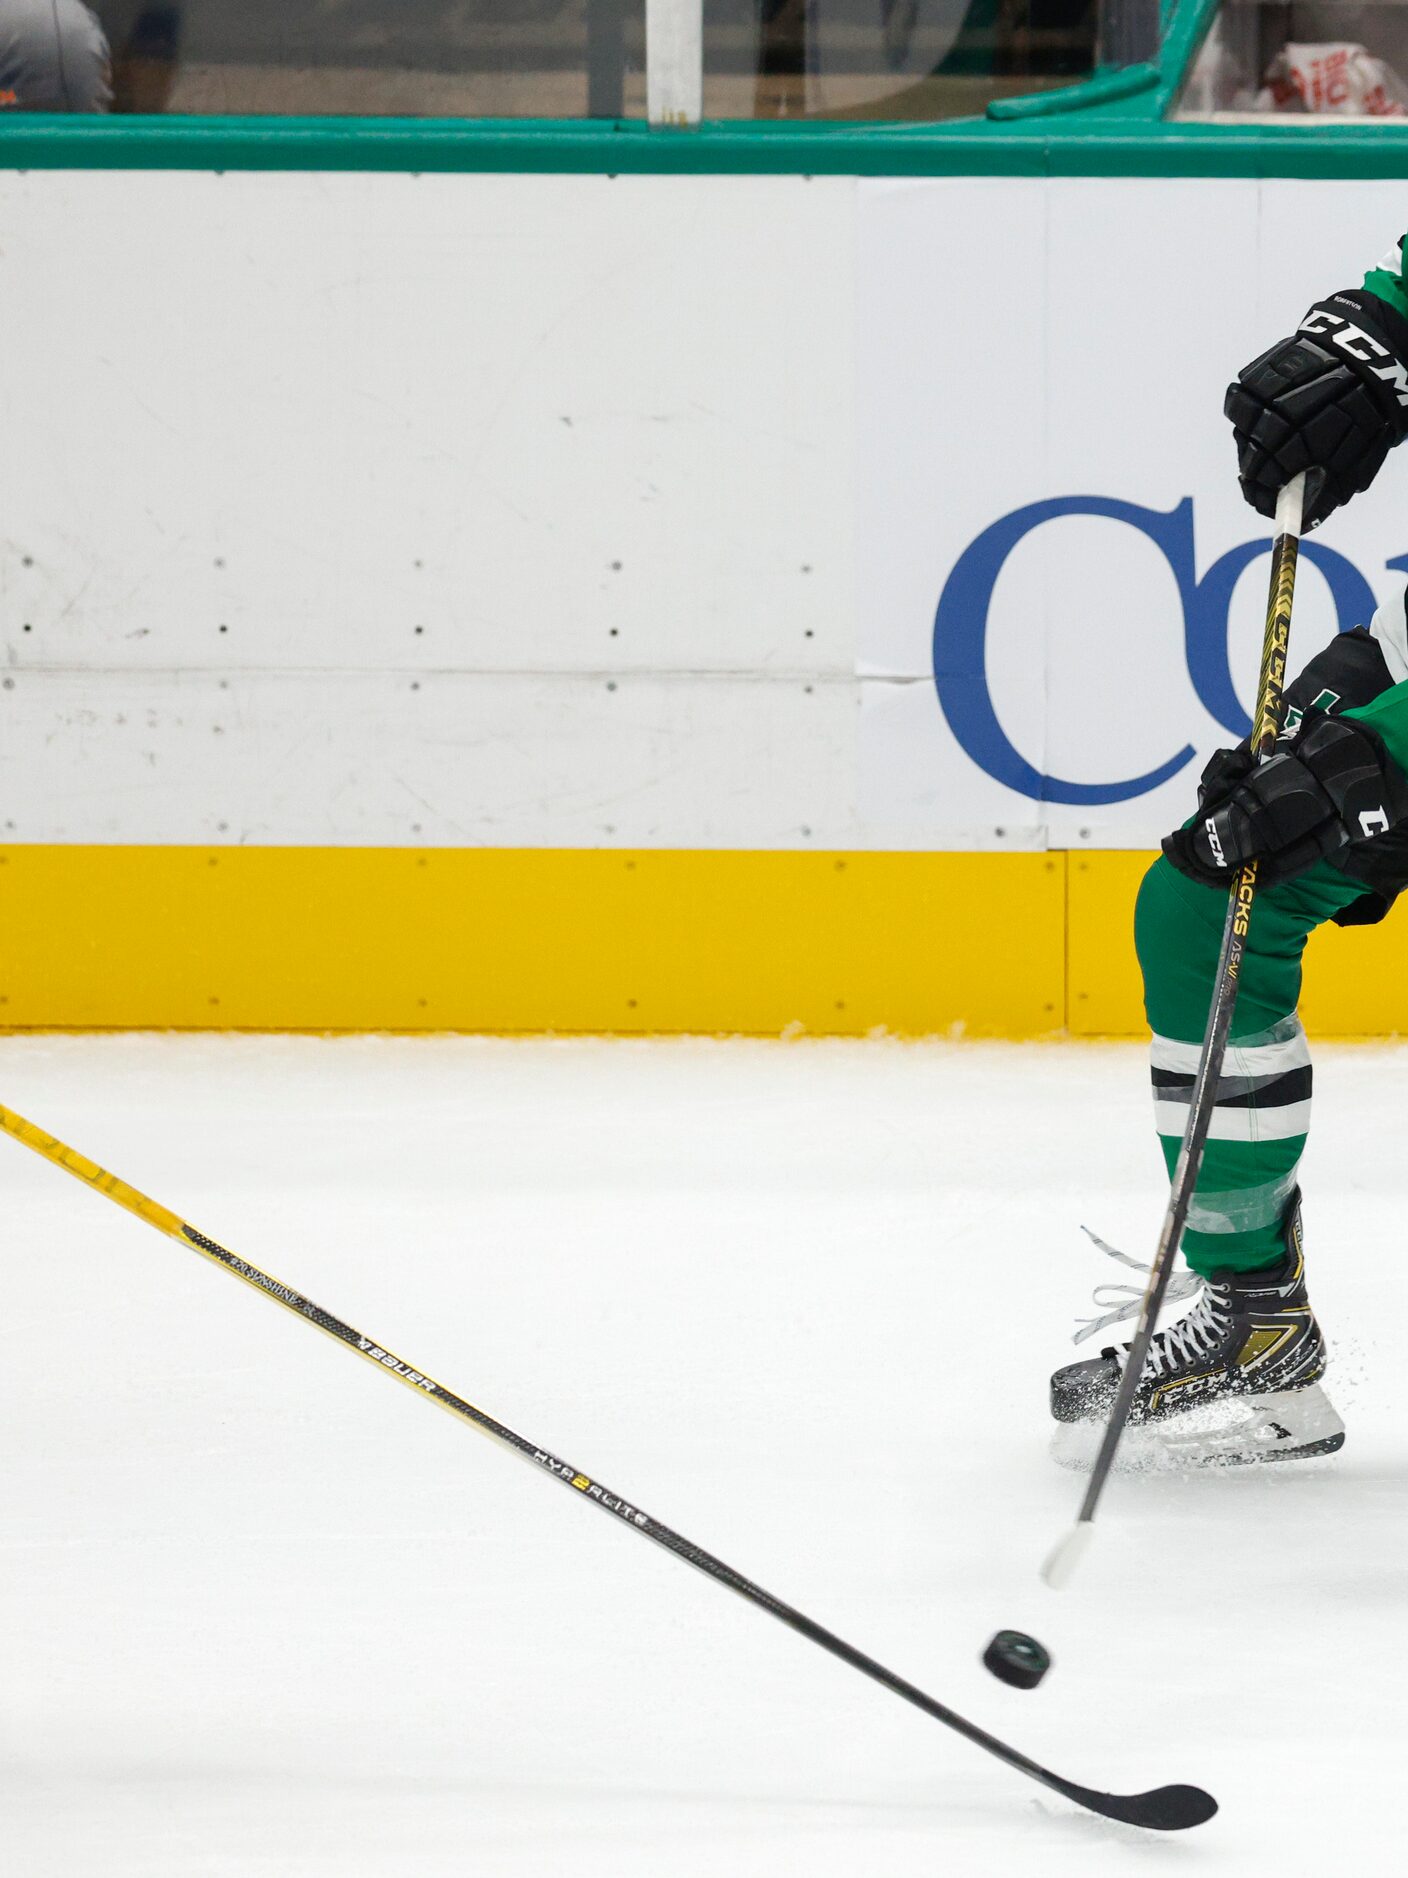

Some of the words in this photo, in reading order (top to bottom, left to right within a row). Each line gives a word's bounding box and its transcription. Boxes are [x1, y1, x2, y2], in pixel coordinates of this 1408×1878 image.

[1266, 613, 1290, 720] CCM
[1205, 817, 1228, 868] CCM
[368, 1343, 437, 1394] BAUER
